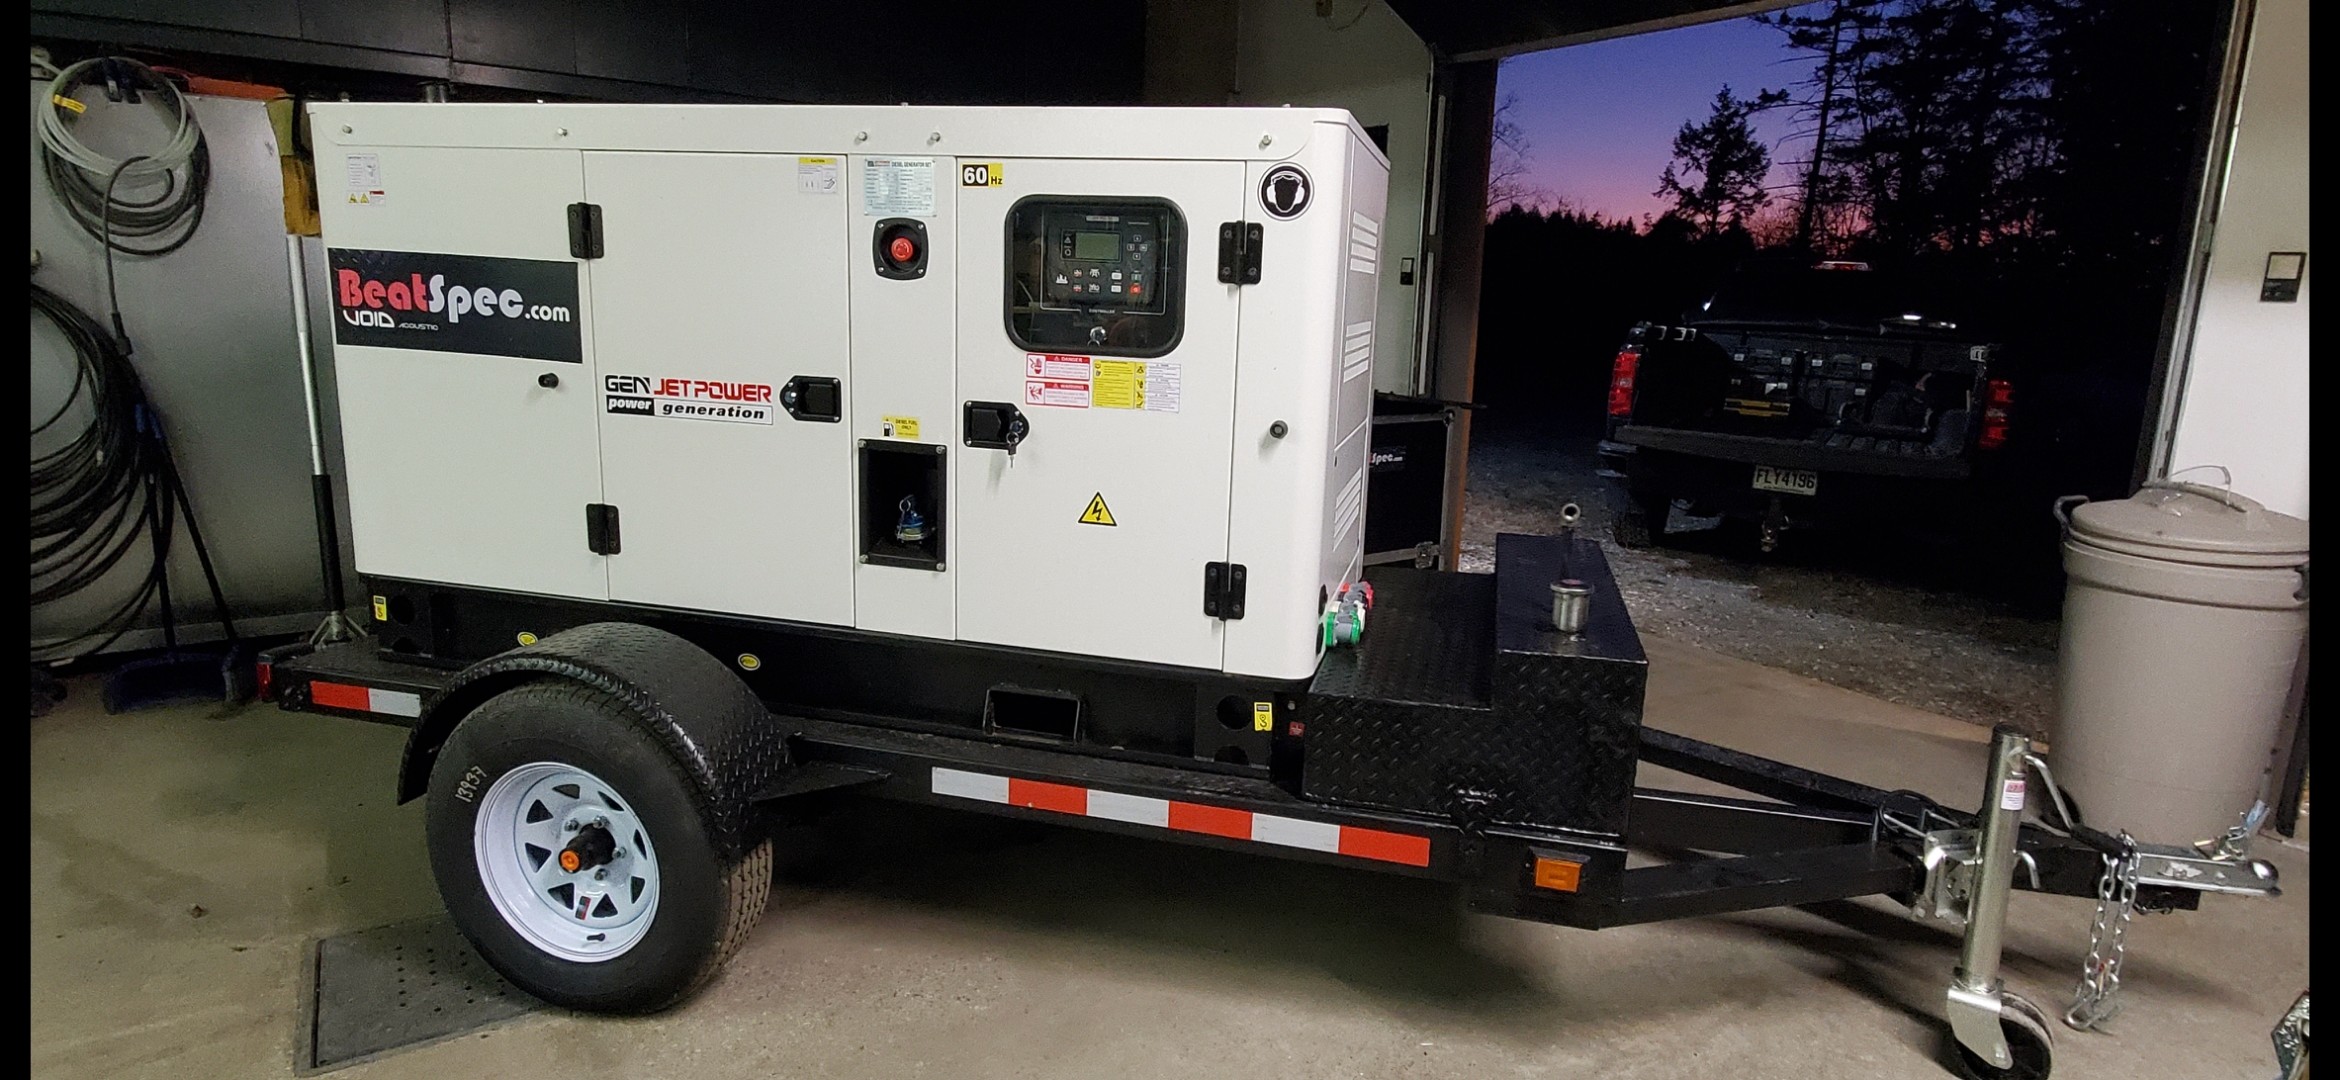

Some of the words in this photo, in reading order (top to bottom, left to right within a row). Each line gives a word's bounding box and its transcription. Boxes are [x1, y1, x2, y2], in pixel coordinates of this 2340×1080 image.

[963, 166, 987, 185] 60
[990, 176, 1003, 185] Hz
[337, 268, 571, 324] BeatSpec.com
[343, 309, 395, 328] VOID
[605, 374, 651, 394] GEN
[608, 397, 652, 411] power
[662, 403, 765, 420] generation
[1756, 468, 1815, 489] FLY4196
